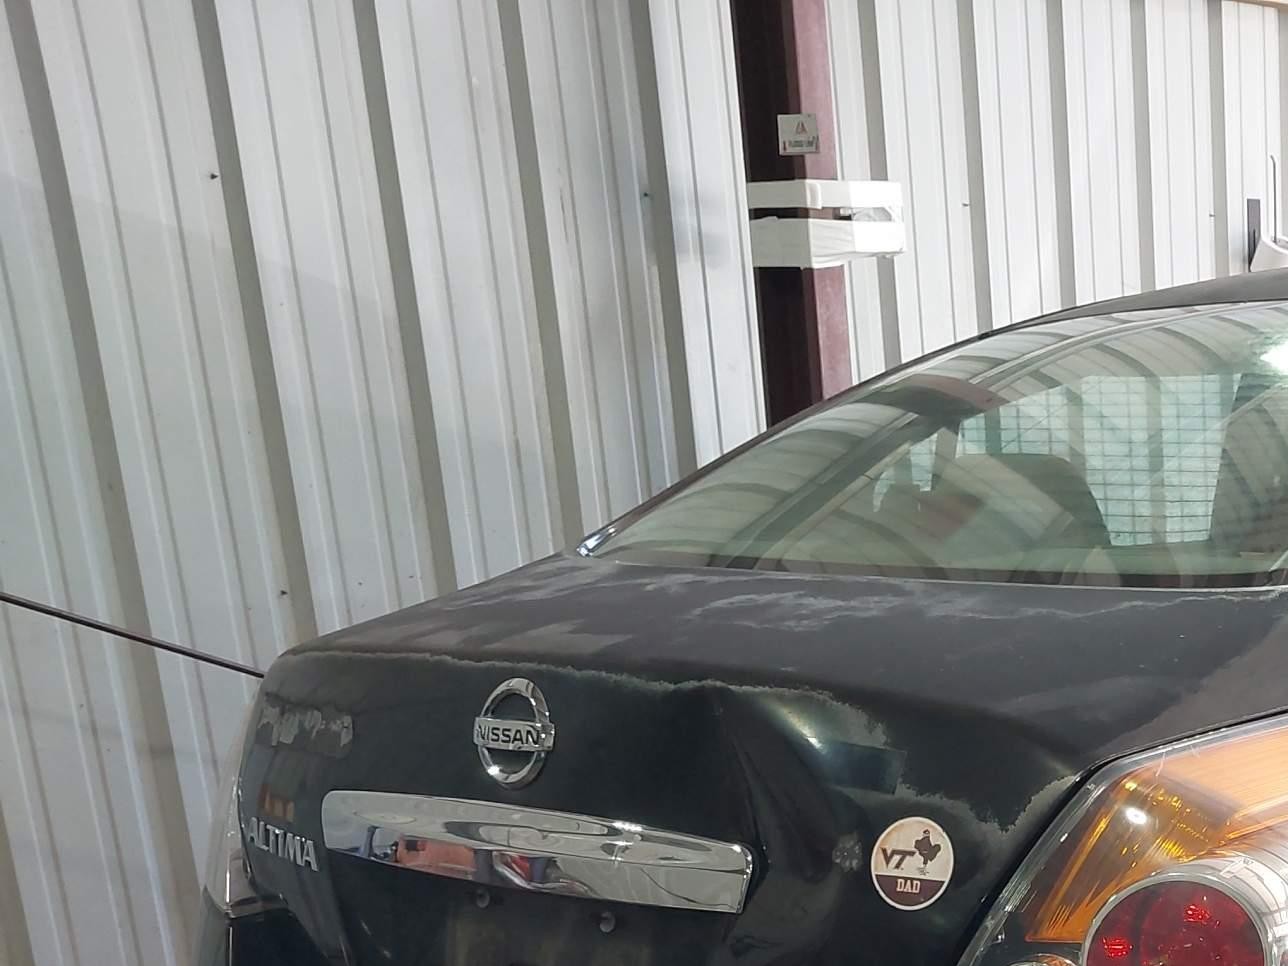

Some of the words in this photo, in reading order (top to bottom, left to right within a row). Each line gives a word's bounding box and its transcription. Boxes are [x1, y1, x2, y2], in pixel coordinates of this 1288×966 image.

[478, 724, 540, 745] NISSAN
[247, 816, 319, 872] ALTIMA
[879, 846, 917, 871] VT
[895, 878, 922, 895] DAD
